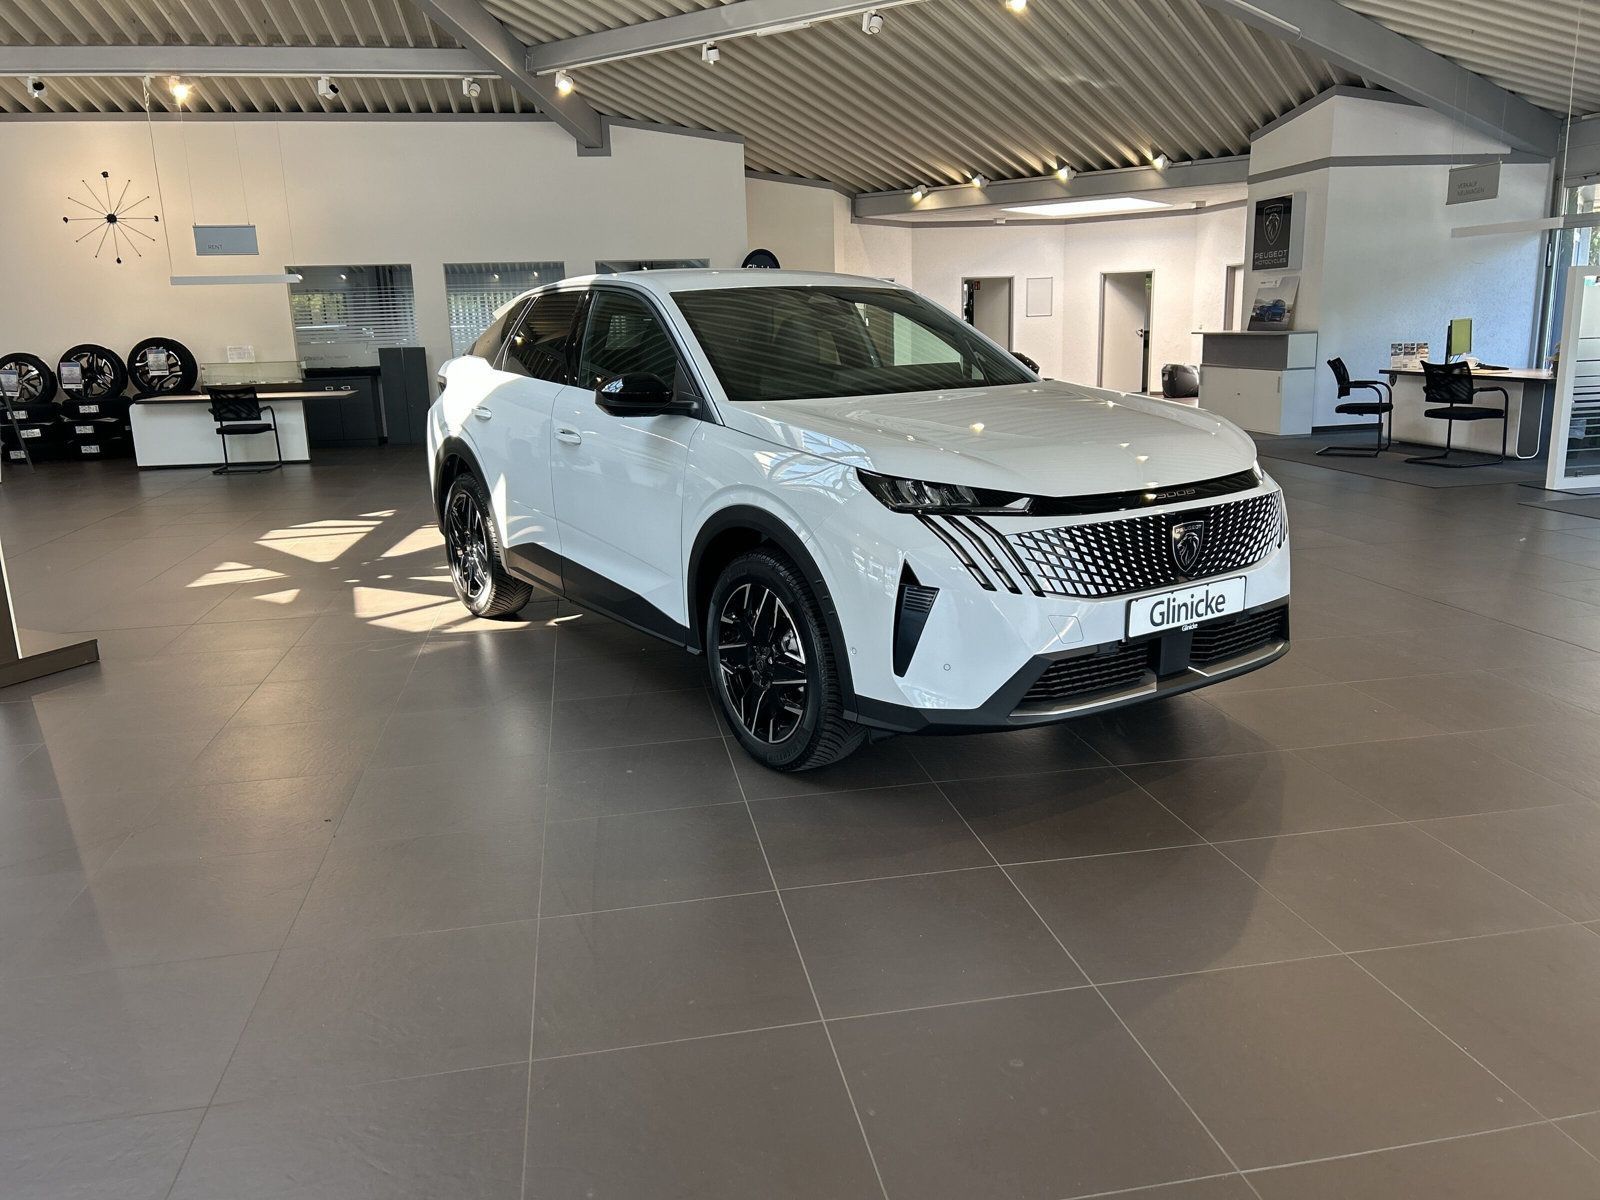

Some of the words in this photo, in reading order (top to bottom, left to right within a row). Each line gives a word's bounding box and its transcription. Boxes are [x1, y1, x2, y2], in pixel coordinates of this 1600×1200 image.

[1254, 249, 1288, 259] PEUGEOT
[1149, 589, 1226, 627] Glinicke
[1181, 622, 1198, 632] Glinicke
